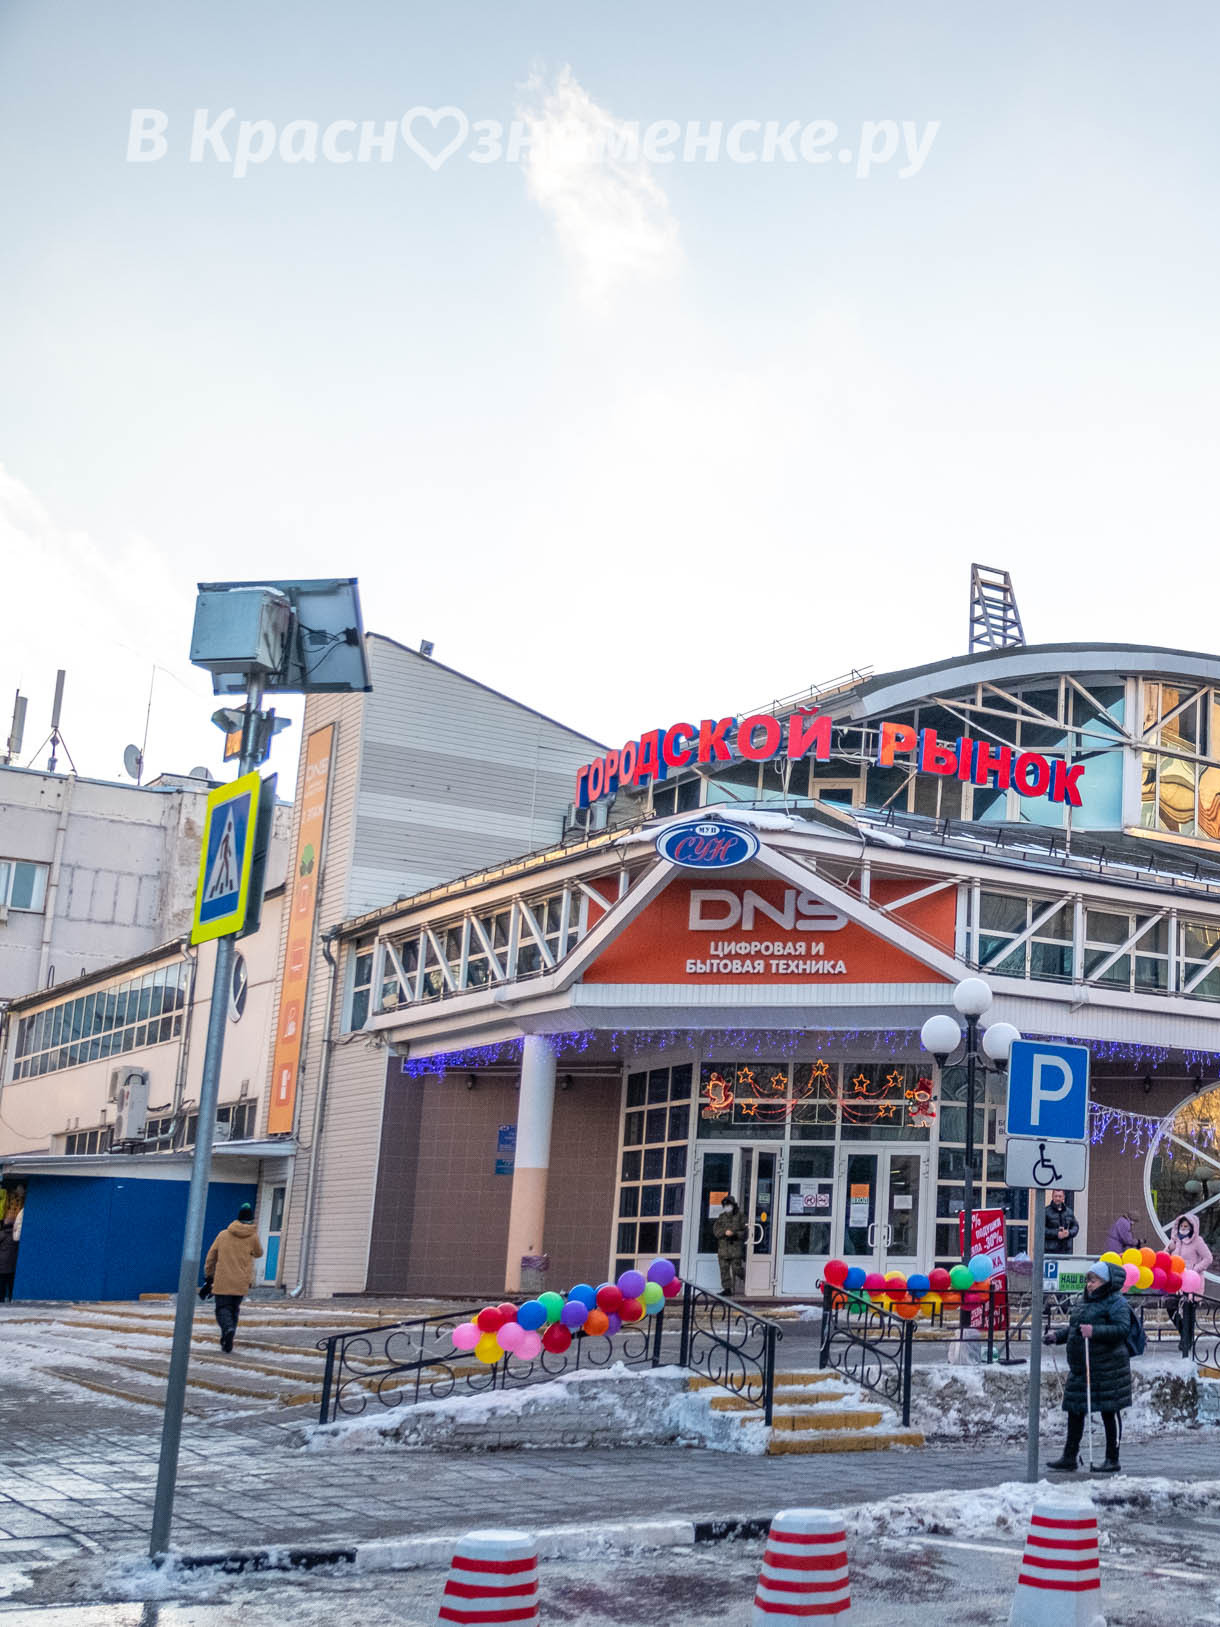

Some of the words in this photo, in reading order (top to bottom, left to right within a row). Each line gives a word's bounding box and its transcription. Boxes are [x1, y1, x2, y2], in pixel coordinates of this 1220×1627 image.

[575, 705, 833, 809] ГОРОДСКОЙ
[877, 721, 1086, 808] РЫНОК
[688, 889, 849, 932] DNS
[686, 959, 765, 974] БЫТОВАЯ
[769, 960, 847, 974] ТЕХНИКА
[709, 941, 806, 958] ЦИФРОВАЯ
[811, 942, 825, 956] И
[1030, 1053, 1074, 1126] P
